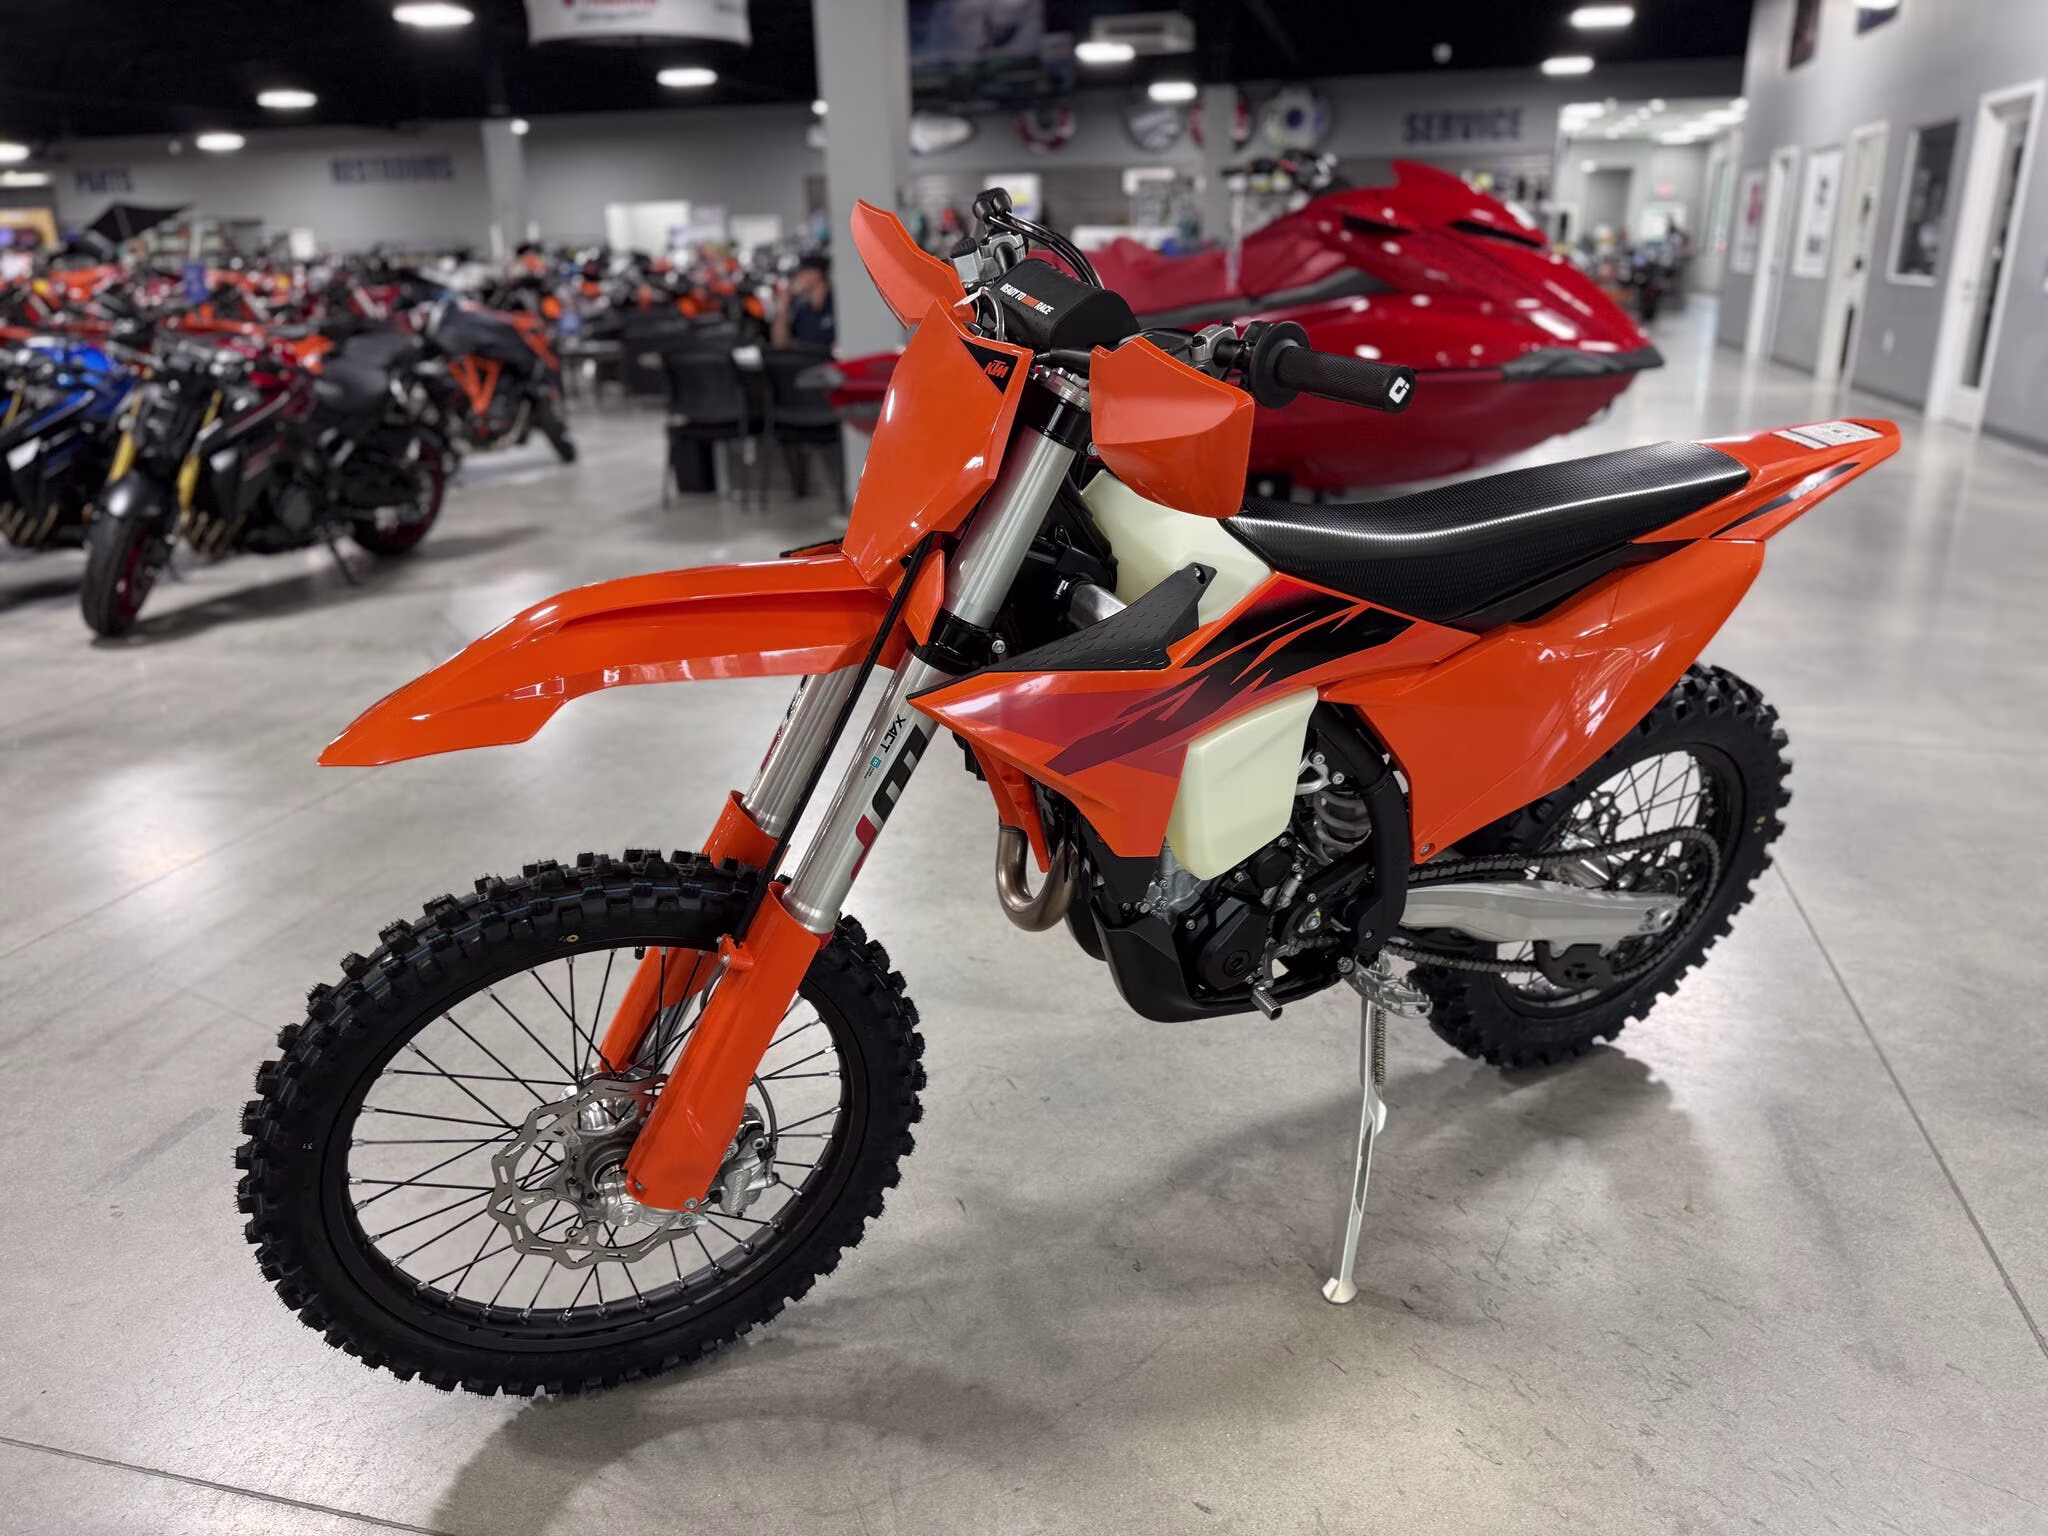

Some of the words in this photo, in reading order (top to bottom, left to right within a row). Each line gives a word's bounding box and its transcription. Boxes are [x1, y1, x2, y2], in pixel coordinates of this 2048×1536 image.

[1404, 108, 1524, 144] SERVICE
[1000, 283, 1020, 297] READY
[1034, 301, 1055, 315] RACE
[984, 360, 1009, 378] KTM
[880, 714, 906, 754] XACT
